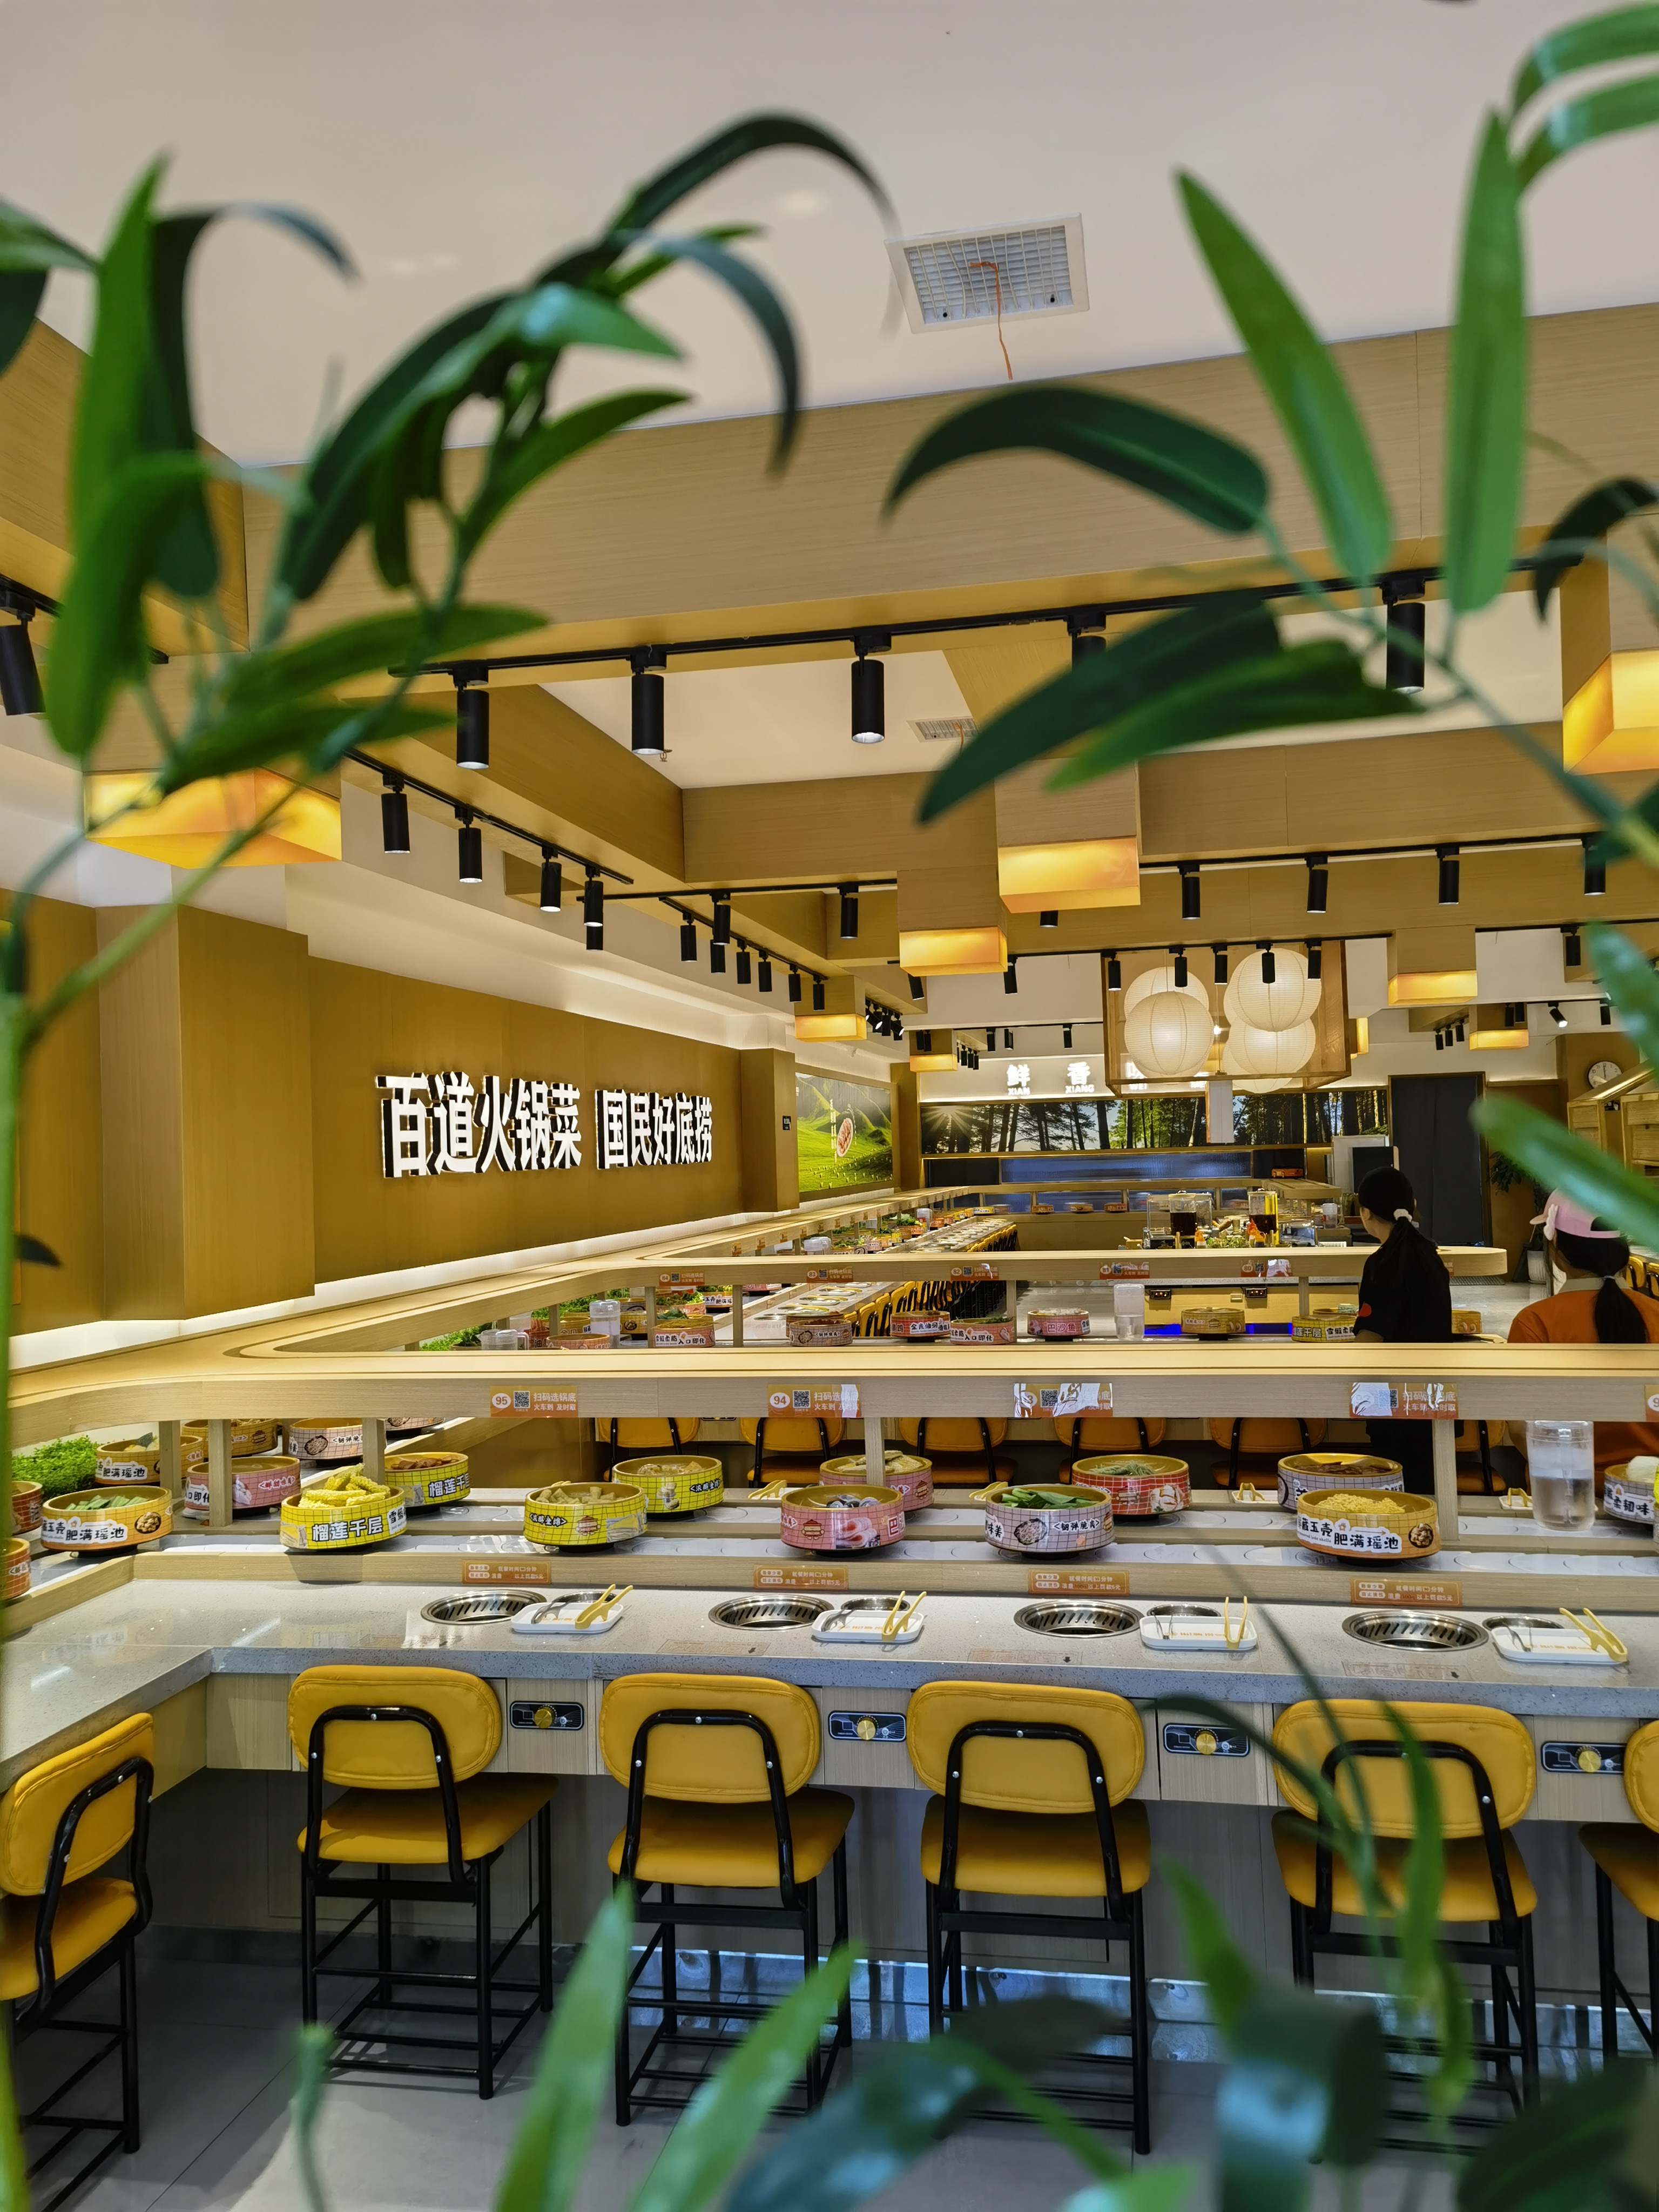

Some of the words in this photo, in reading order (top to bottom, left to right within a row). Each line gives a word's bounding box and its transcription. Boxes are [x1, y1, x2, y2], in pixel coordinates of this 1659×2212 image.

[1067, 1062, 1090, 1085] 香
[1008, 1087, 1030, 1095] XIAN
[1065, 1084, 1095, 1094] XIANG
[375, 1071, 582, 1178] 百道火锅菜
[595, 1088, 712, 1170] 国民好底捞
[1047, 1323, 1077, 1333] 巴沙鱼
[495, 1396, 508, 1405] 95
[534, 1392, 576, 1402] 扫码选锅底
[773, 1395, 787, 1405] 94
[814, 1403, 836, 1411] 火车到
[103, 1468, 145, 1478] 肥满瑶池
[186, 1491, 210, 1502] 口即化
[65, 1527, 124, 1541] 肥满瑶池
[312, 1515, 383, 1542] 榴莲千层
[1334, 1533, 1399, 1549] 肥满瑶池
